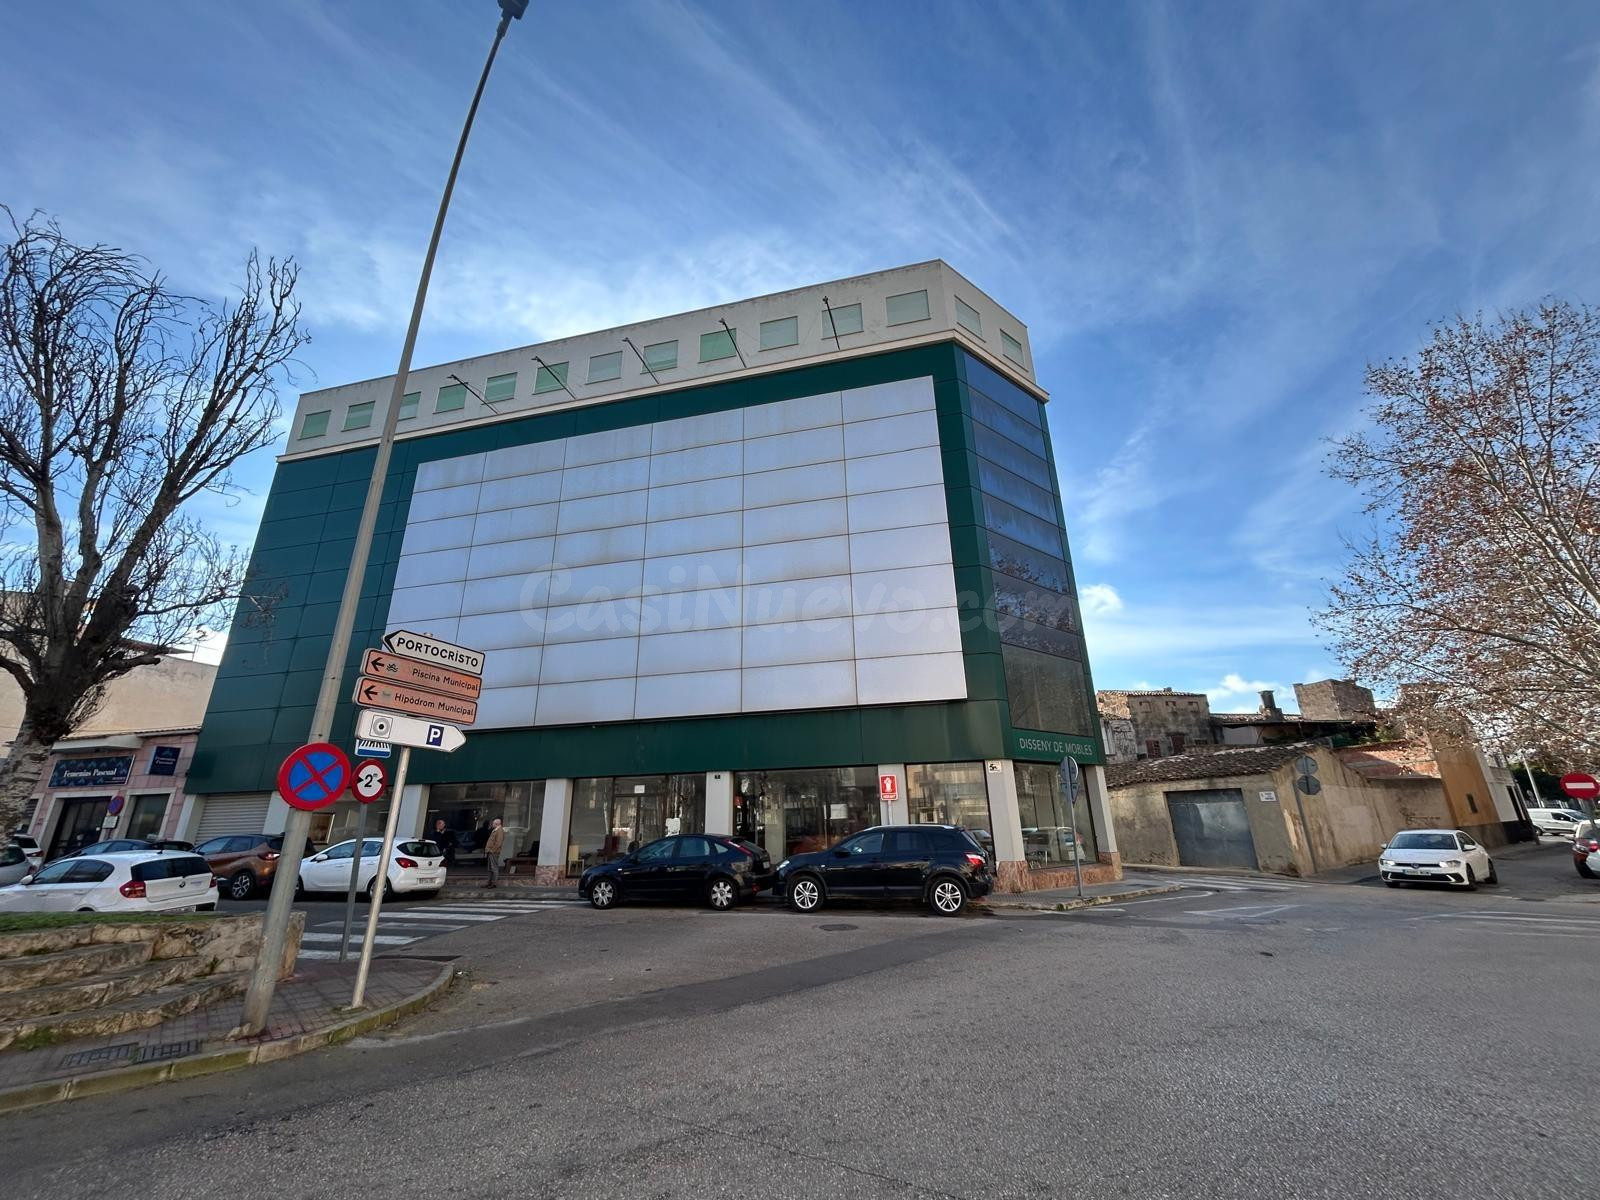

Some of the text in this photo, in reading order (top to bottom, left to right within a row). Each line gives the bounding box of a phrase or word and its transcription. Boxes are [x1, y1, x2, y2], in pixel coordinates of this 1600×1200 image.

[397, 637, 478, 666] PORTOCRISTO
[412, 668, 478, 691] Piscina Municipal
[438, 703, 474, 716] Municipal
[429, 729, 441, 743] P
[1019, 738, 1093, 756] DISSENY DE MOBLES
